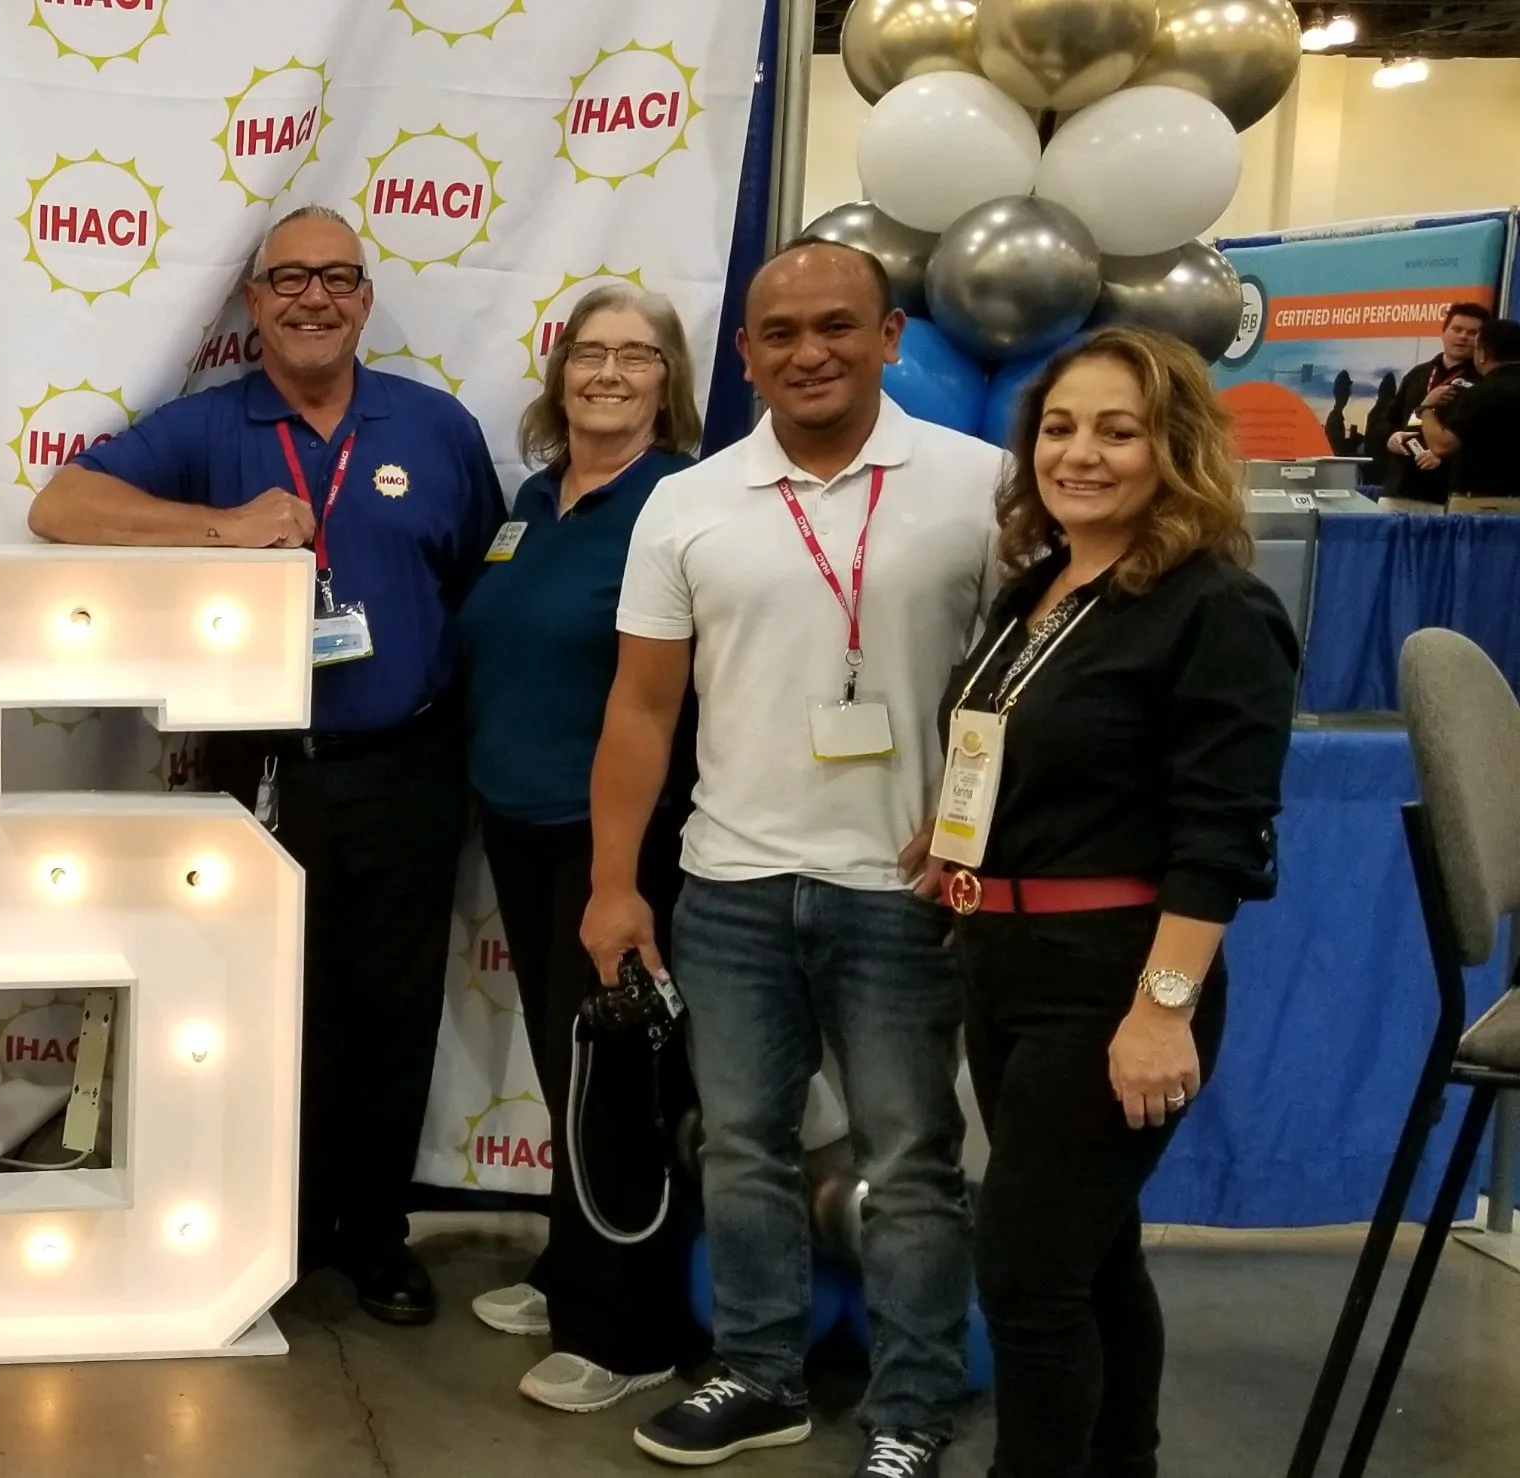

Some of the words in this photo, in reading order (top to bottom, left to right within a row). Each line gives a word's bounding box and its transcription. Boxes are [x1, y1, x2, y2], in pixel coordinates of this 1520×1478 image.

[235, 105, 317, 157] IHACI
[571, 91, 680, 134] IHACI
[373, 179, 483, 220] IHACI
[39, 204, 149, 247] IHACI
[1275, 308, 1330, 327] CERTIFIED
[1332, 306, 1361, 325] HIGH
[192, 328, 263, 374] IHAC
[379, 476, 405, 486] IHACI
[781, 481, 795, 502] IHAC
[815, 553, 831, 576] IHACI
[476, 1136, 553, 1170] IHAC
